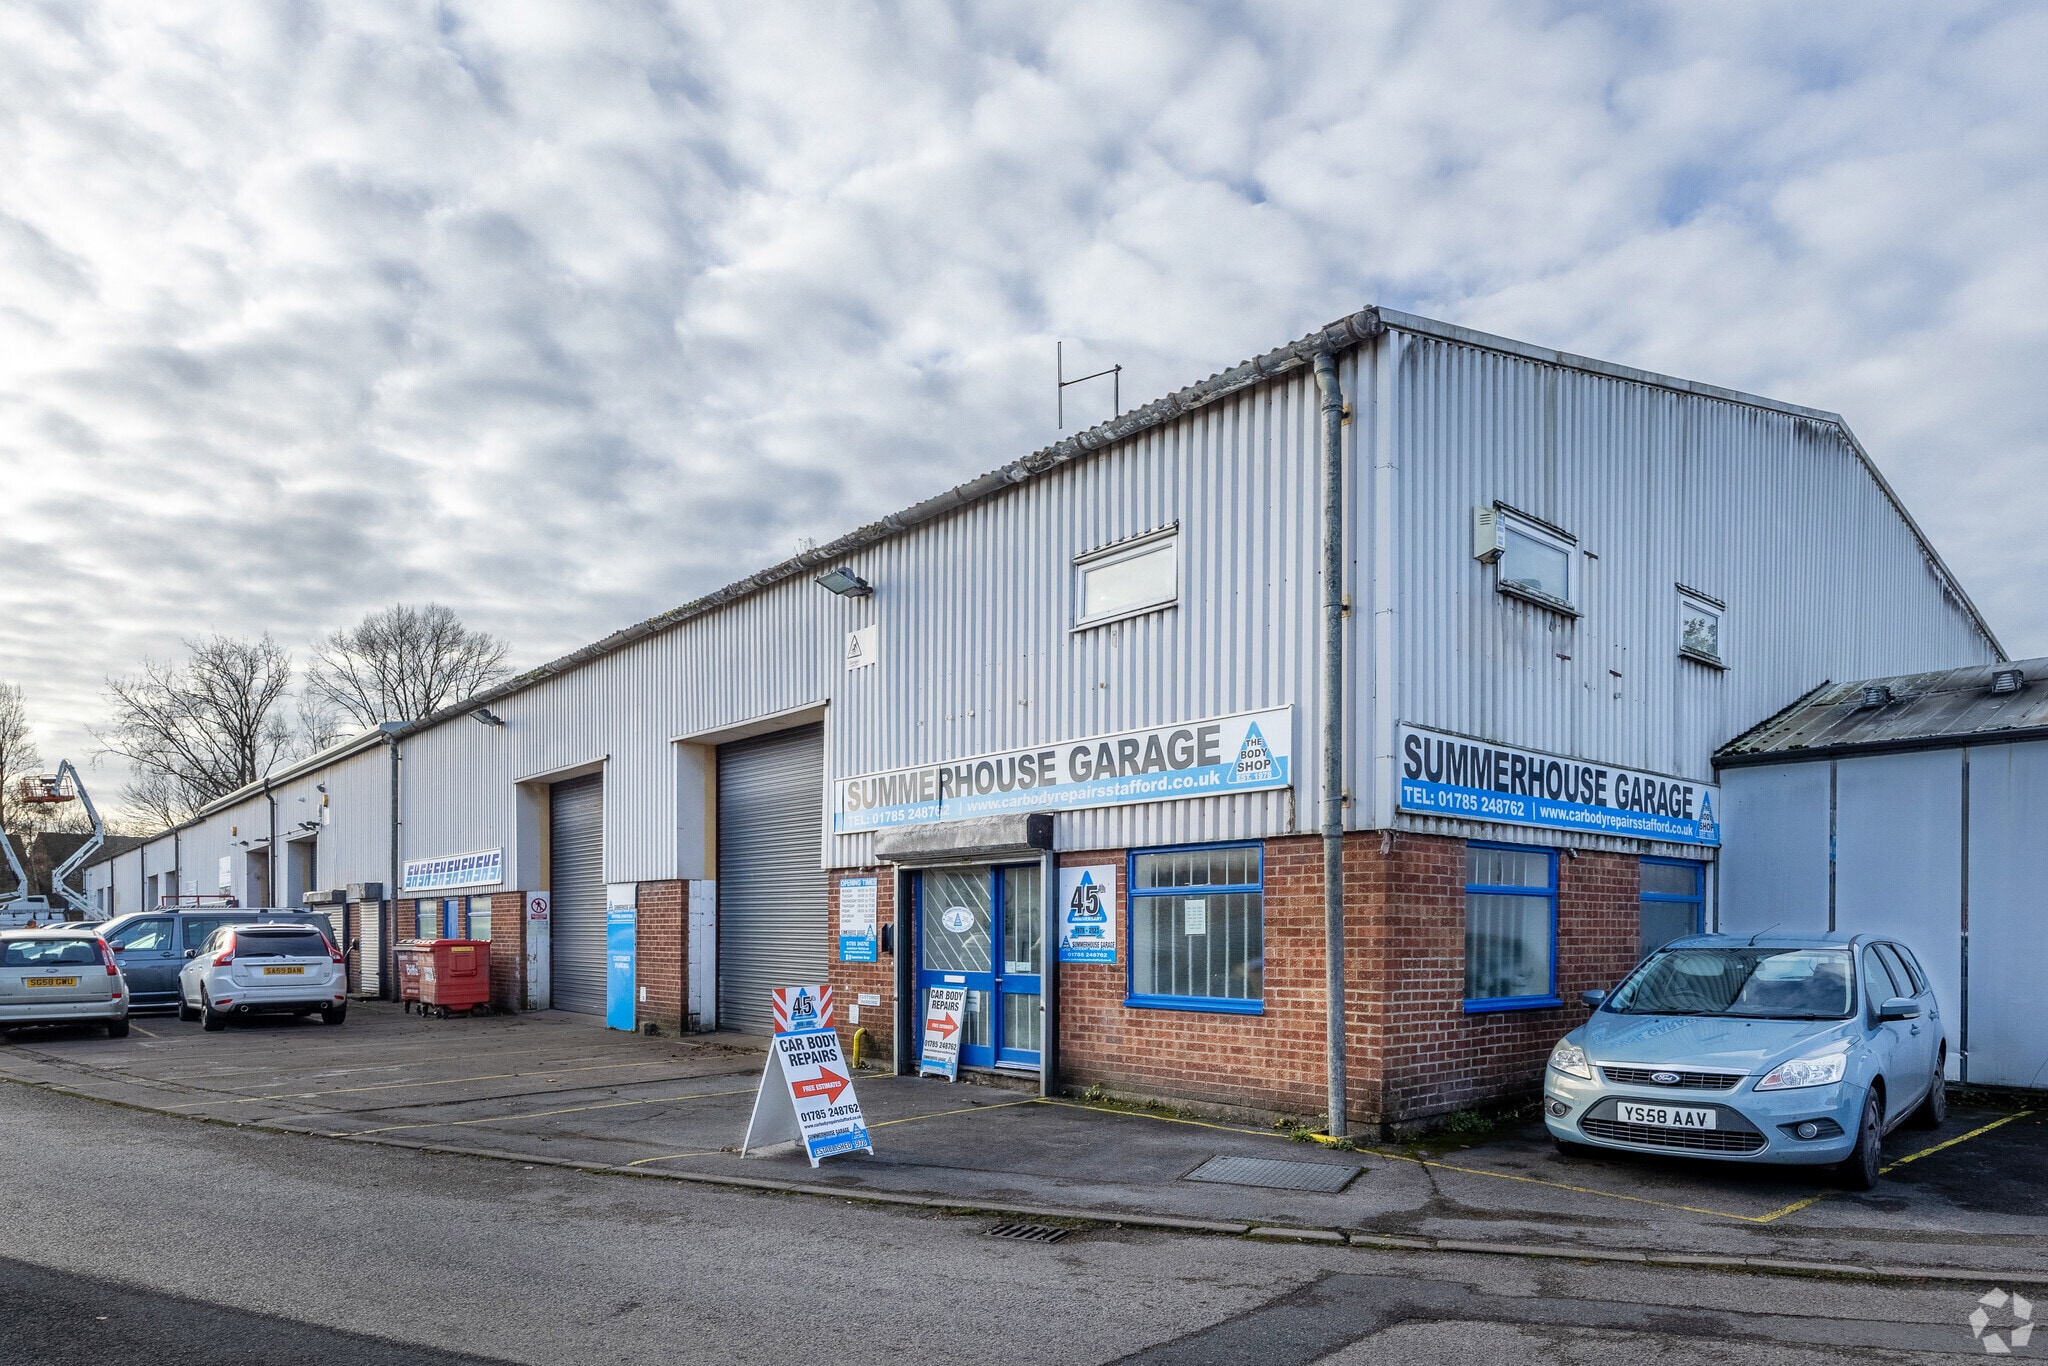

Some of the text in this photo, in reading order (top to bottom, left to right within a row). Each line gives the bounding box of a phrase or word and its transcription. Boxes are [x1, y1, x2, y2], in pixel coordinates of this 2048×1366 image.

[1246, 738, 1262, 747] THE
[1240, 748, 1268, 759] BODY
[847, 725, 1221, 811] SUMMERHOUSE GARAGE
[1237, 760, 1271, 772] SHOP
[1403, 734, 1693, 820] SUMMERHOUSE GARAGE
[848, 769, 1221, 826] TEL: 01785 248762 www.carbodyrepairsstafford.co.uk
[1404, 786, 1693, 836] TEL: 01785 248762 www.carbodyrepairsstafford.co.uk
[1700, 822, 1714, 831] SHOP
[931, 989, 944, 1000] CAR
[946, 991, 964, 1001] BODY
[931, 1000, 960, 1012] REPAIRS
[779, 1034, 837, 1053] CAR BODY
[924, 1039, 939, 1048] 01785
[788, 1049, 838, 1067] REPAIRS
[801, 1103, 860, 1123] 01785 248762
[1624, 1106, 1707, 1128] YS58 AAV
